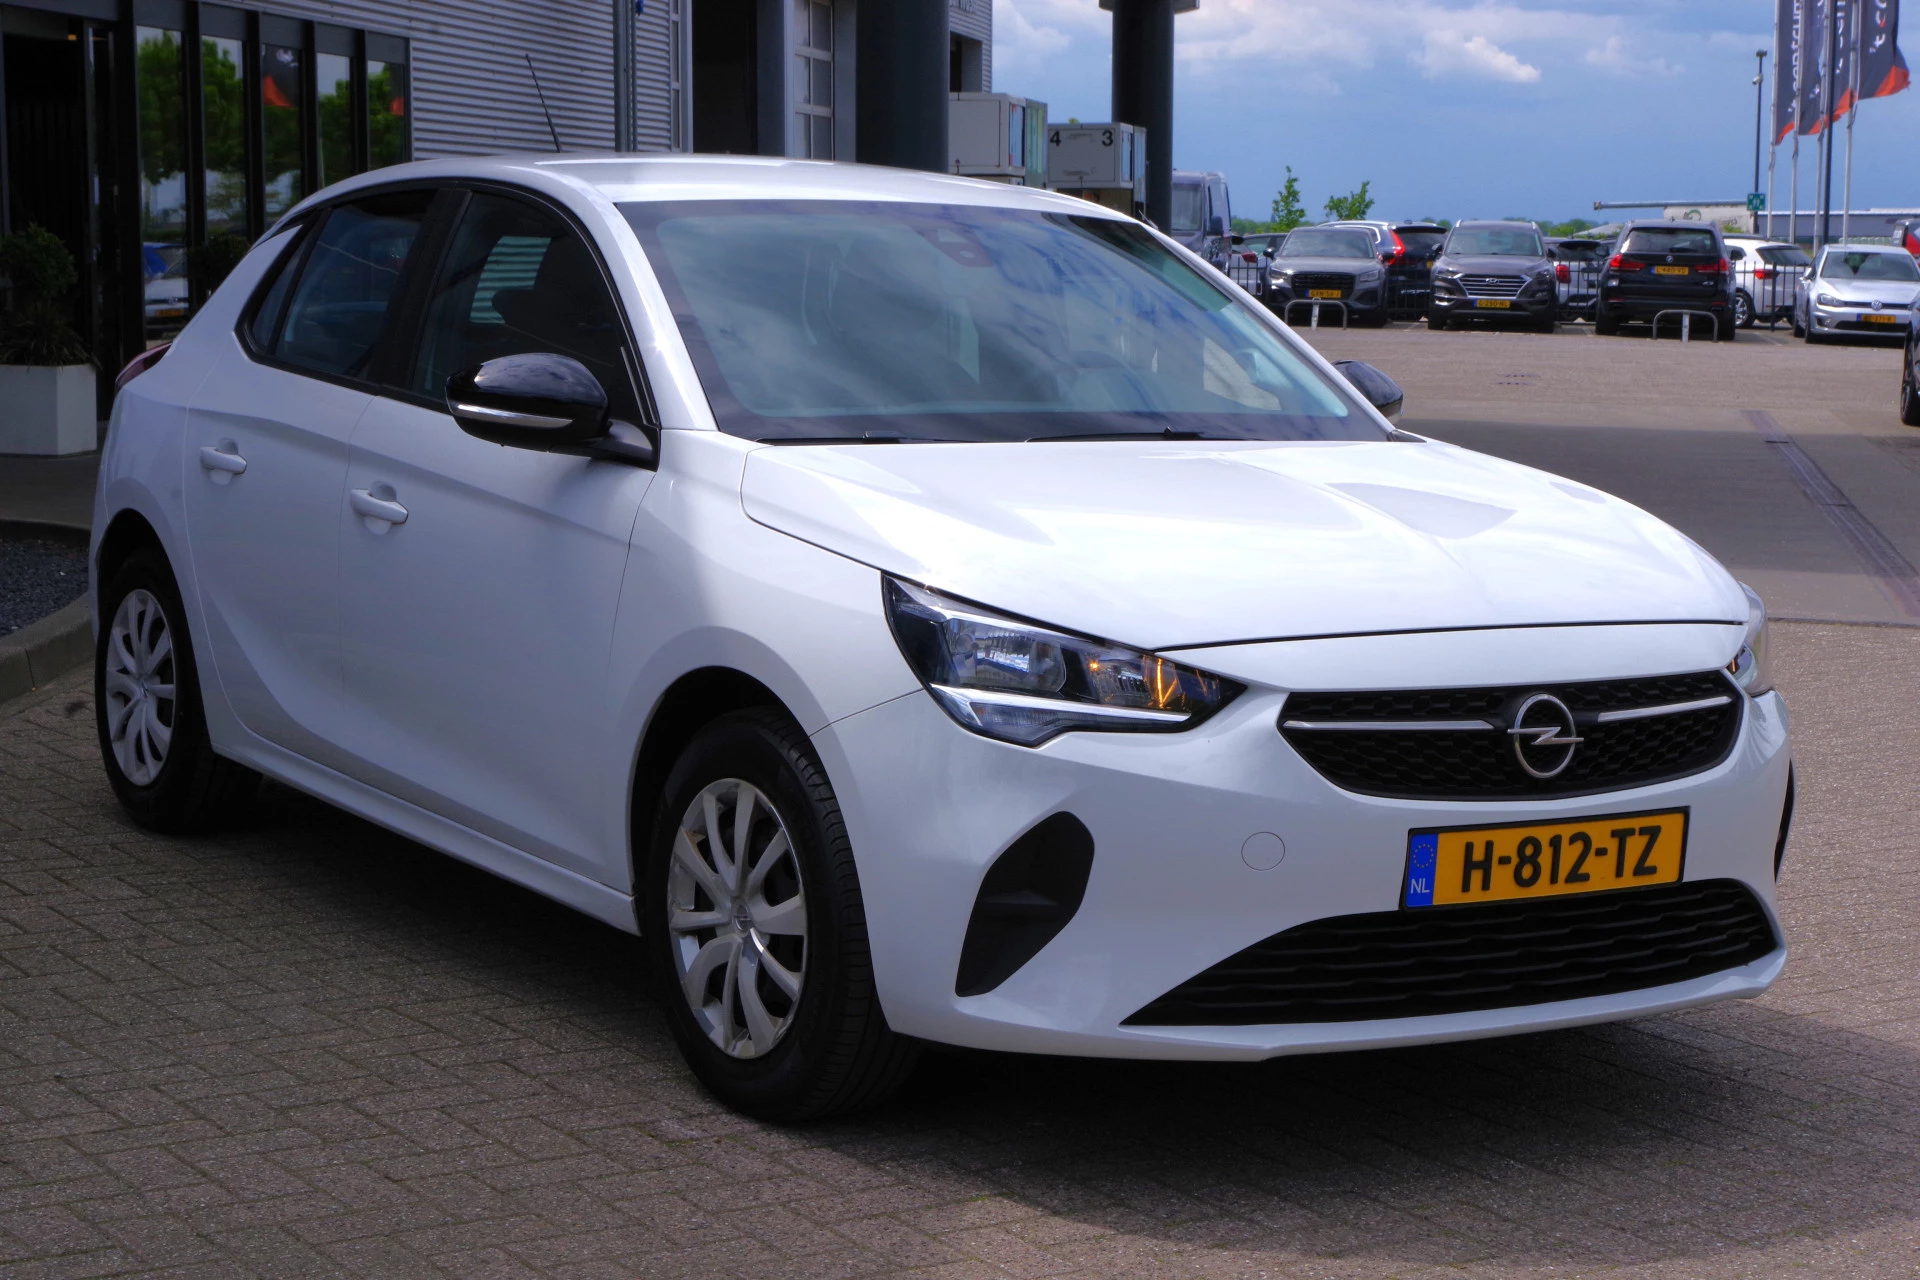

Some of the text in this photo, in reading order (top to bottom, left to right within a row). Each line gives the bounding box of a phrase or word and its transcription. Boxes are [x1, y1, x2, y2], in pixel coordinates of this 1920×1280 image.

[1049, 130, 1113, 147] 4 3
[1461, 825, 1662, 893] H-812-TZ
[1410, 878, 1430, 894] NL
